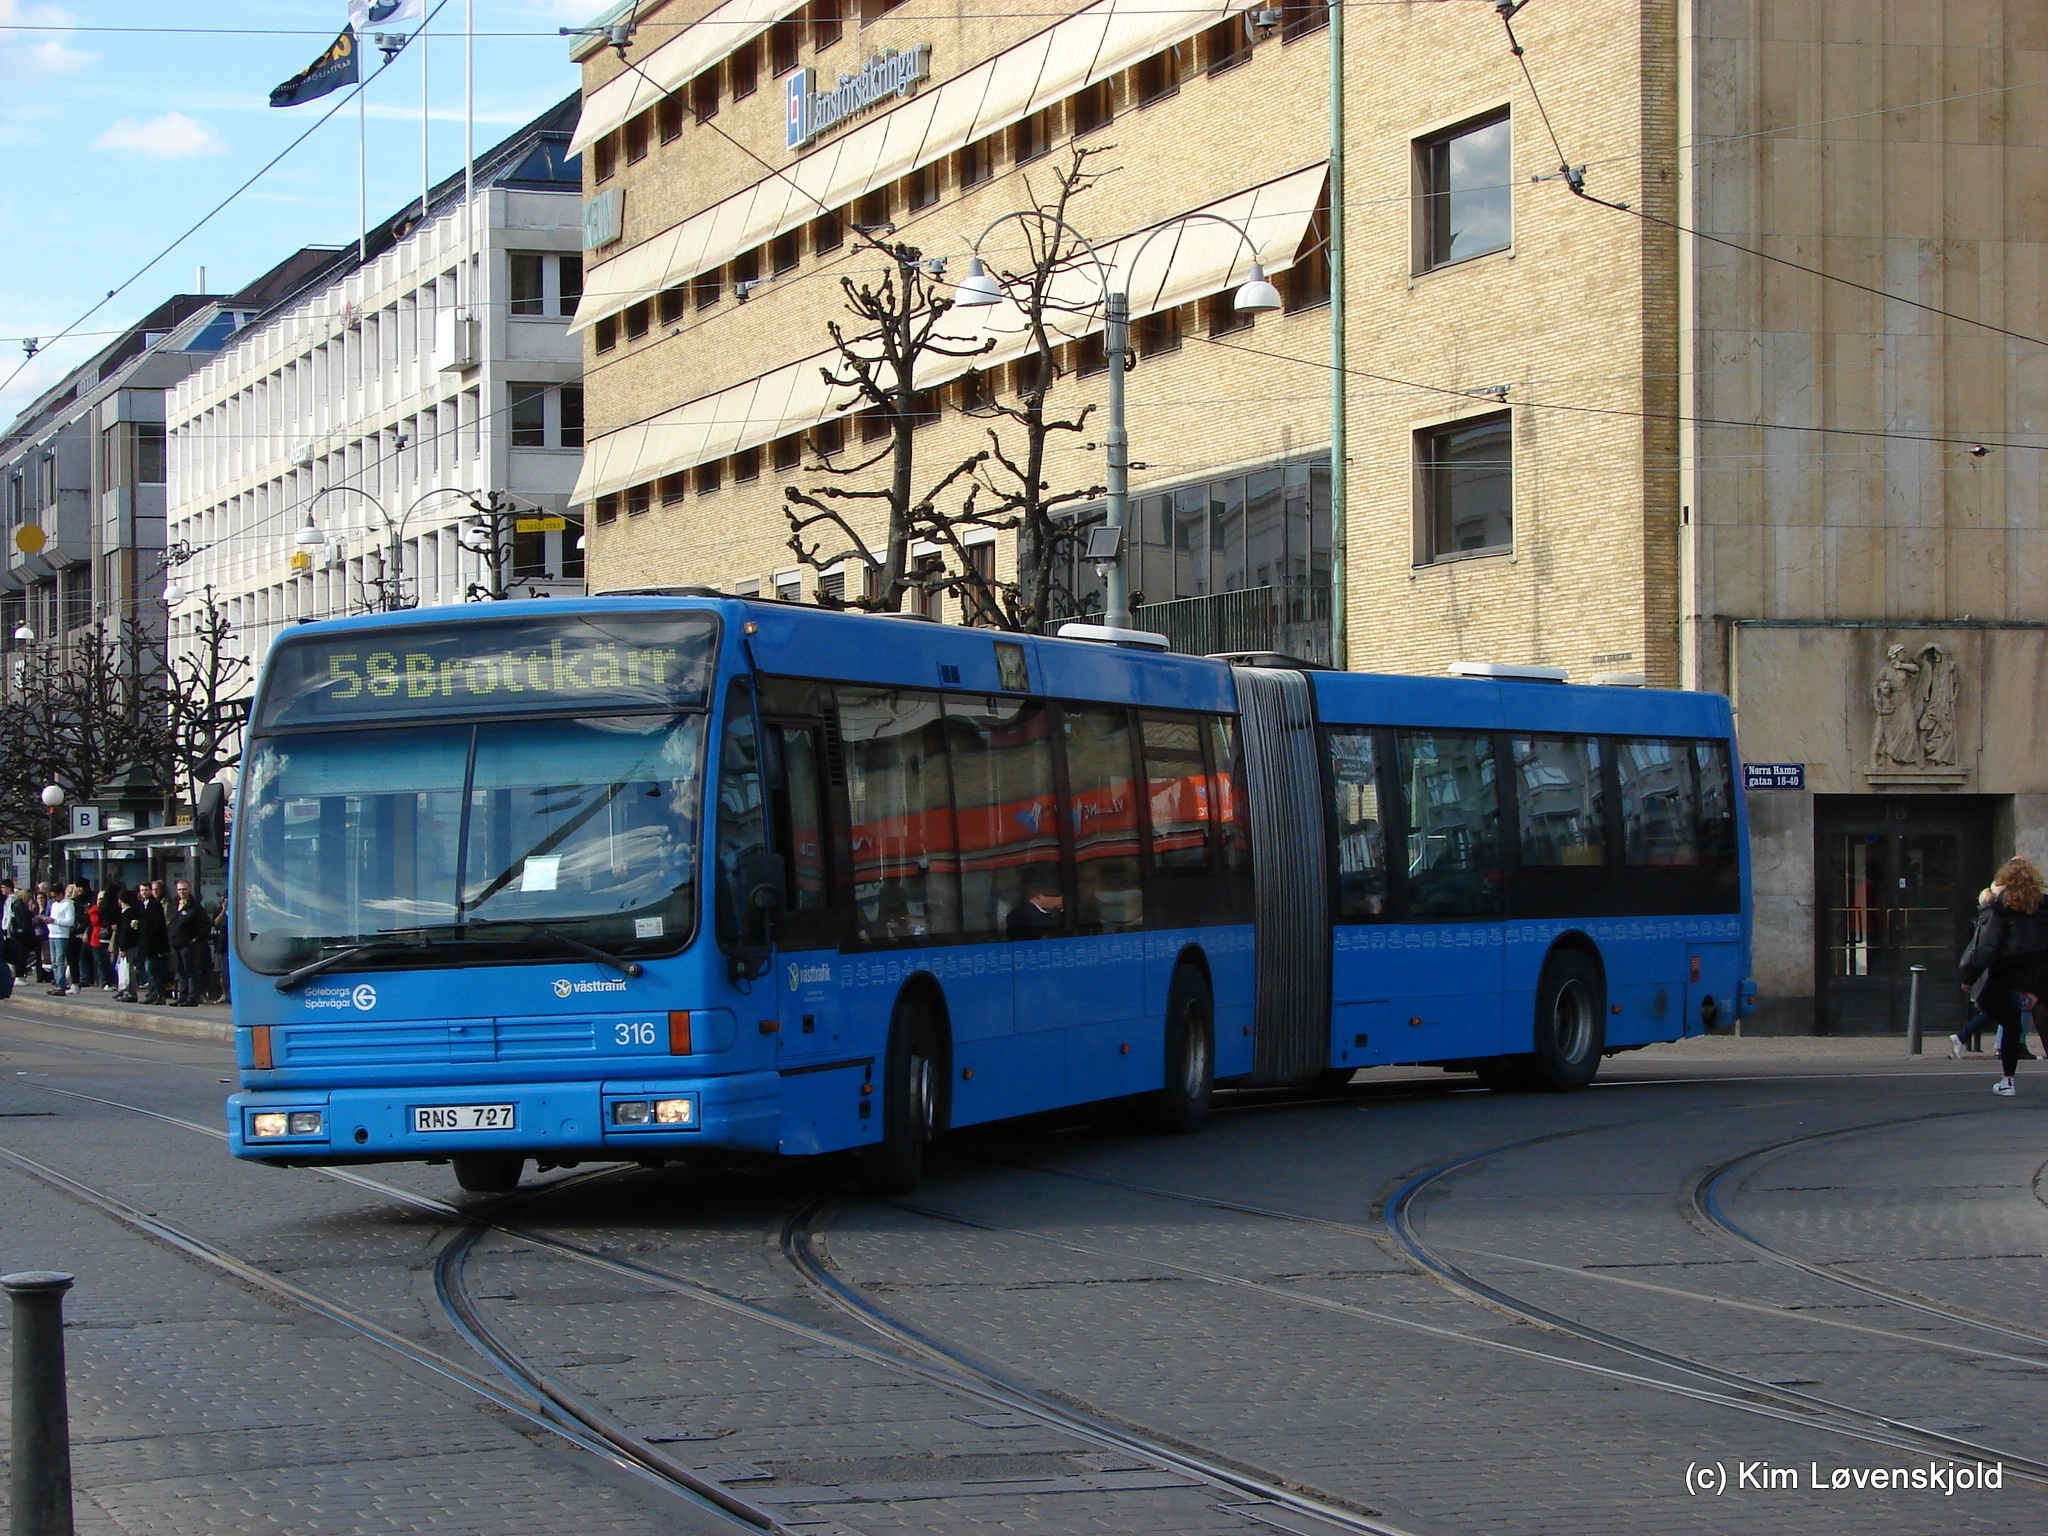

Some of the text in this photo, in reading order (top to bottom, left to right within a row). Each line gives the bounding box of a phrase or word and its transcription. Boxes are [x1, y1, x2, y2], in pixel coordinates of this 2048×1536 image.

[1748, 765, 1800, 775] Norra Hamn-
[1748, 776, 1799, 787] gatan 18-40
[80, 813, 91, 826] B
[15, 843, 27, 856] N
[800, 962, 831, 984] västtrafik
[304, 986, 350, 997] Göteborgs
[573, 978, 627, 993] västtrafik
[304, 998, 350, 1009] Spårvägar
[614, 1022, 656, 1046] 316
[419, 1106, 513, 1129] RNS 727
